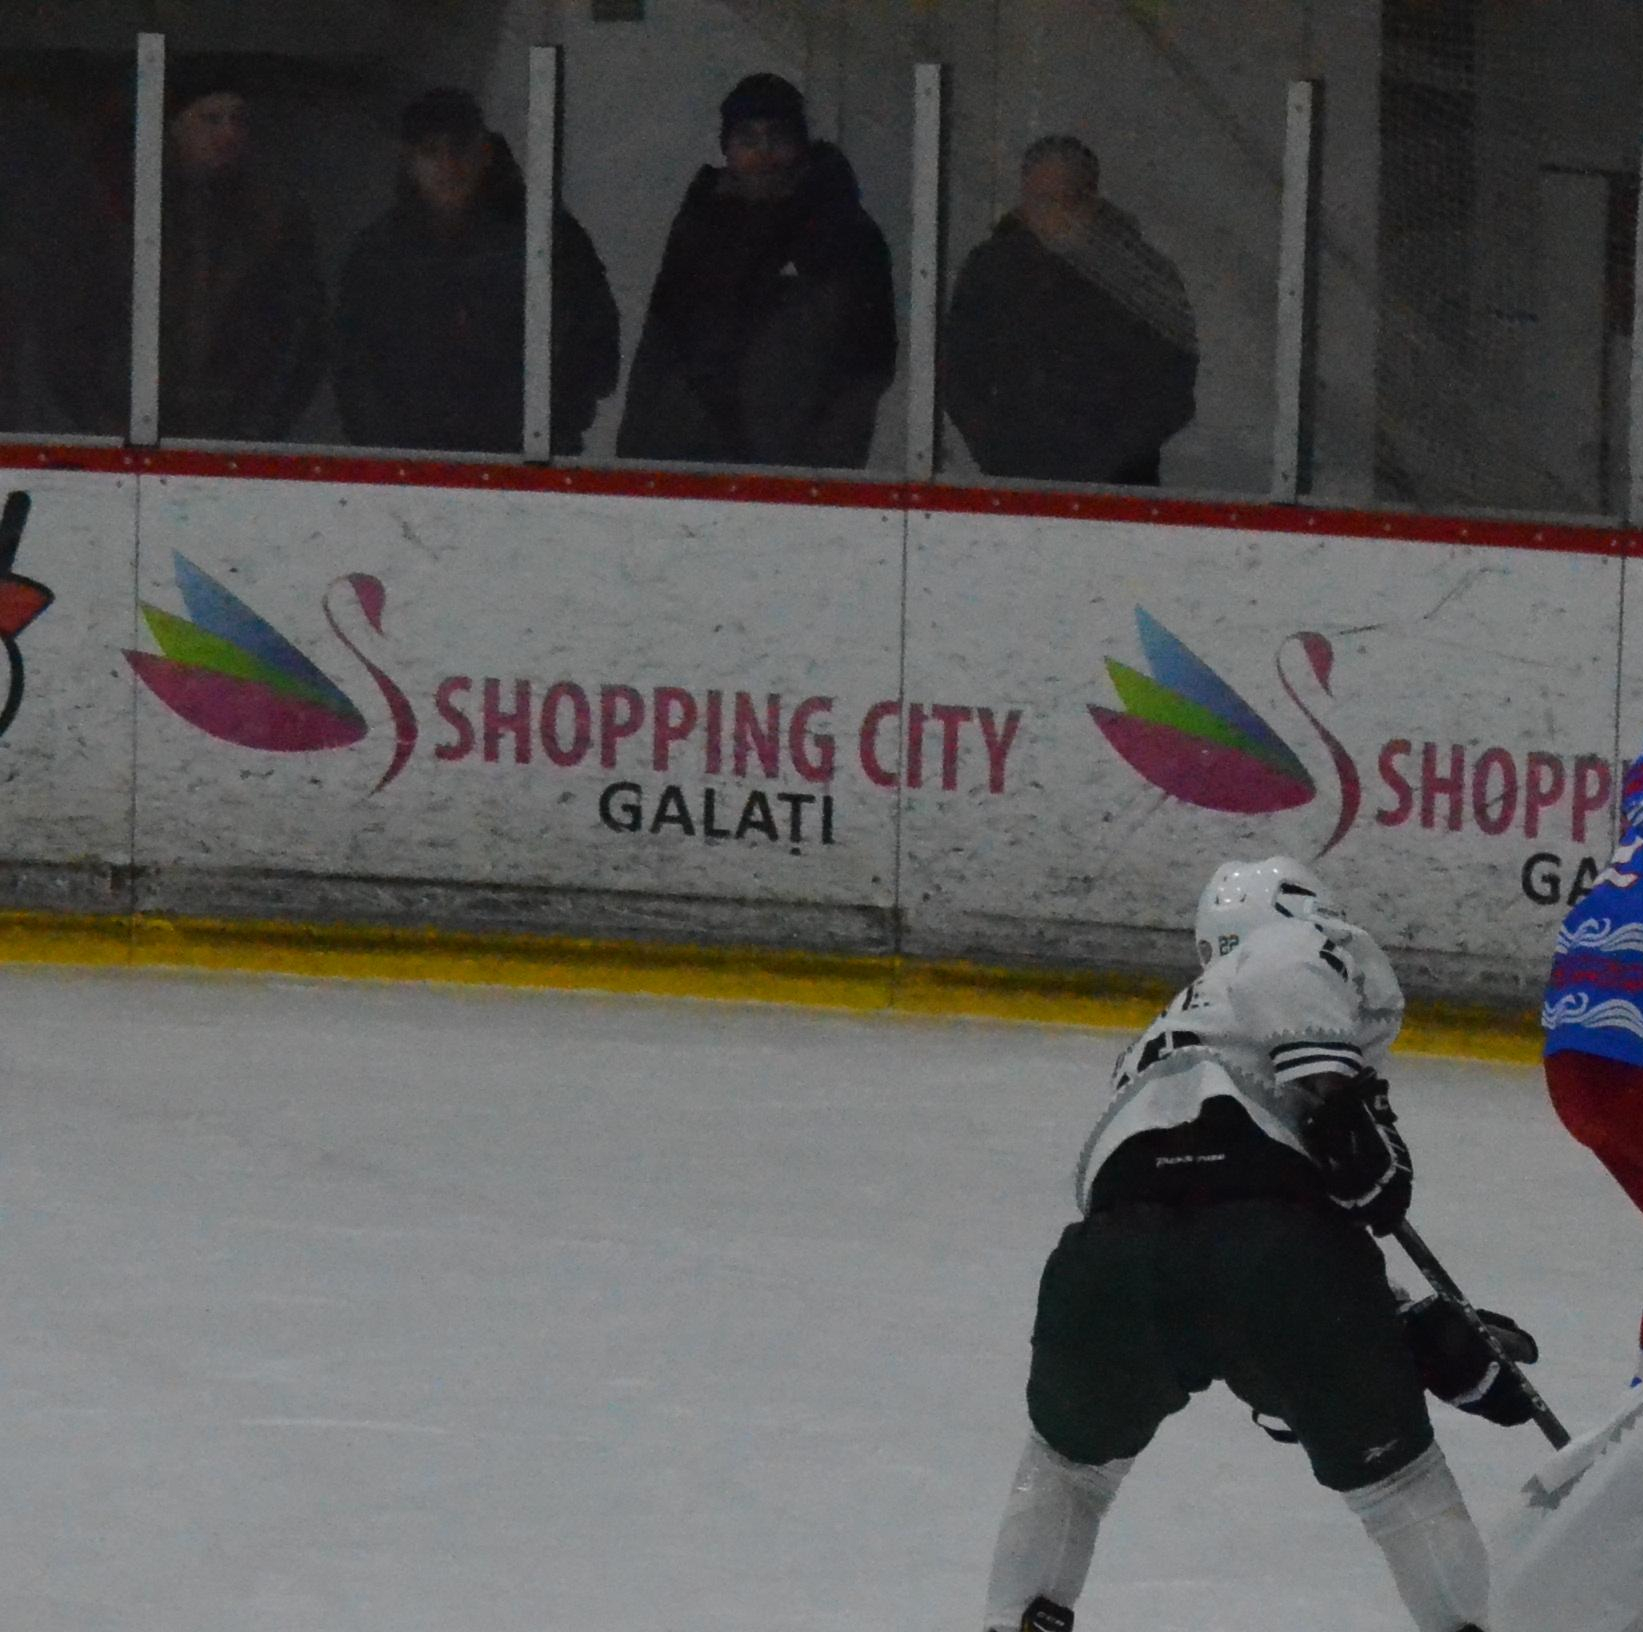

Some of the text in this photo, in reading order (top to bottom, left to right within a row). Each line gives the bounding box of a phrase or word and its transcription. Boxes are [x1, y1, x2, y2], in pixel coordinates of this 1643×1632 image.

[432, 675, 1023, 794] SHOPPING CITY
[1376, 737, 1630, 843] SHOPP
